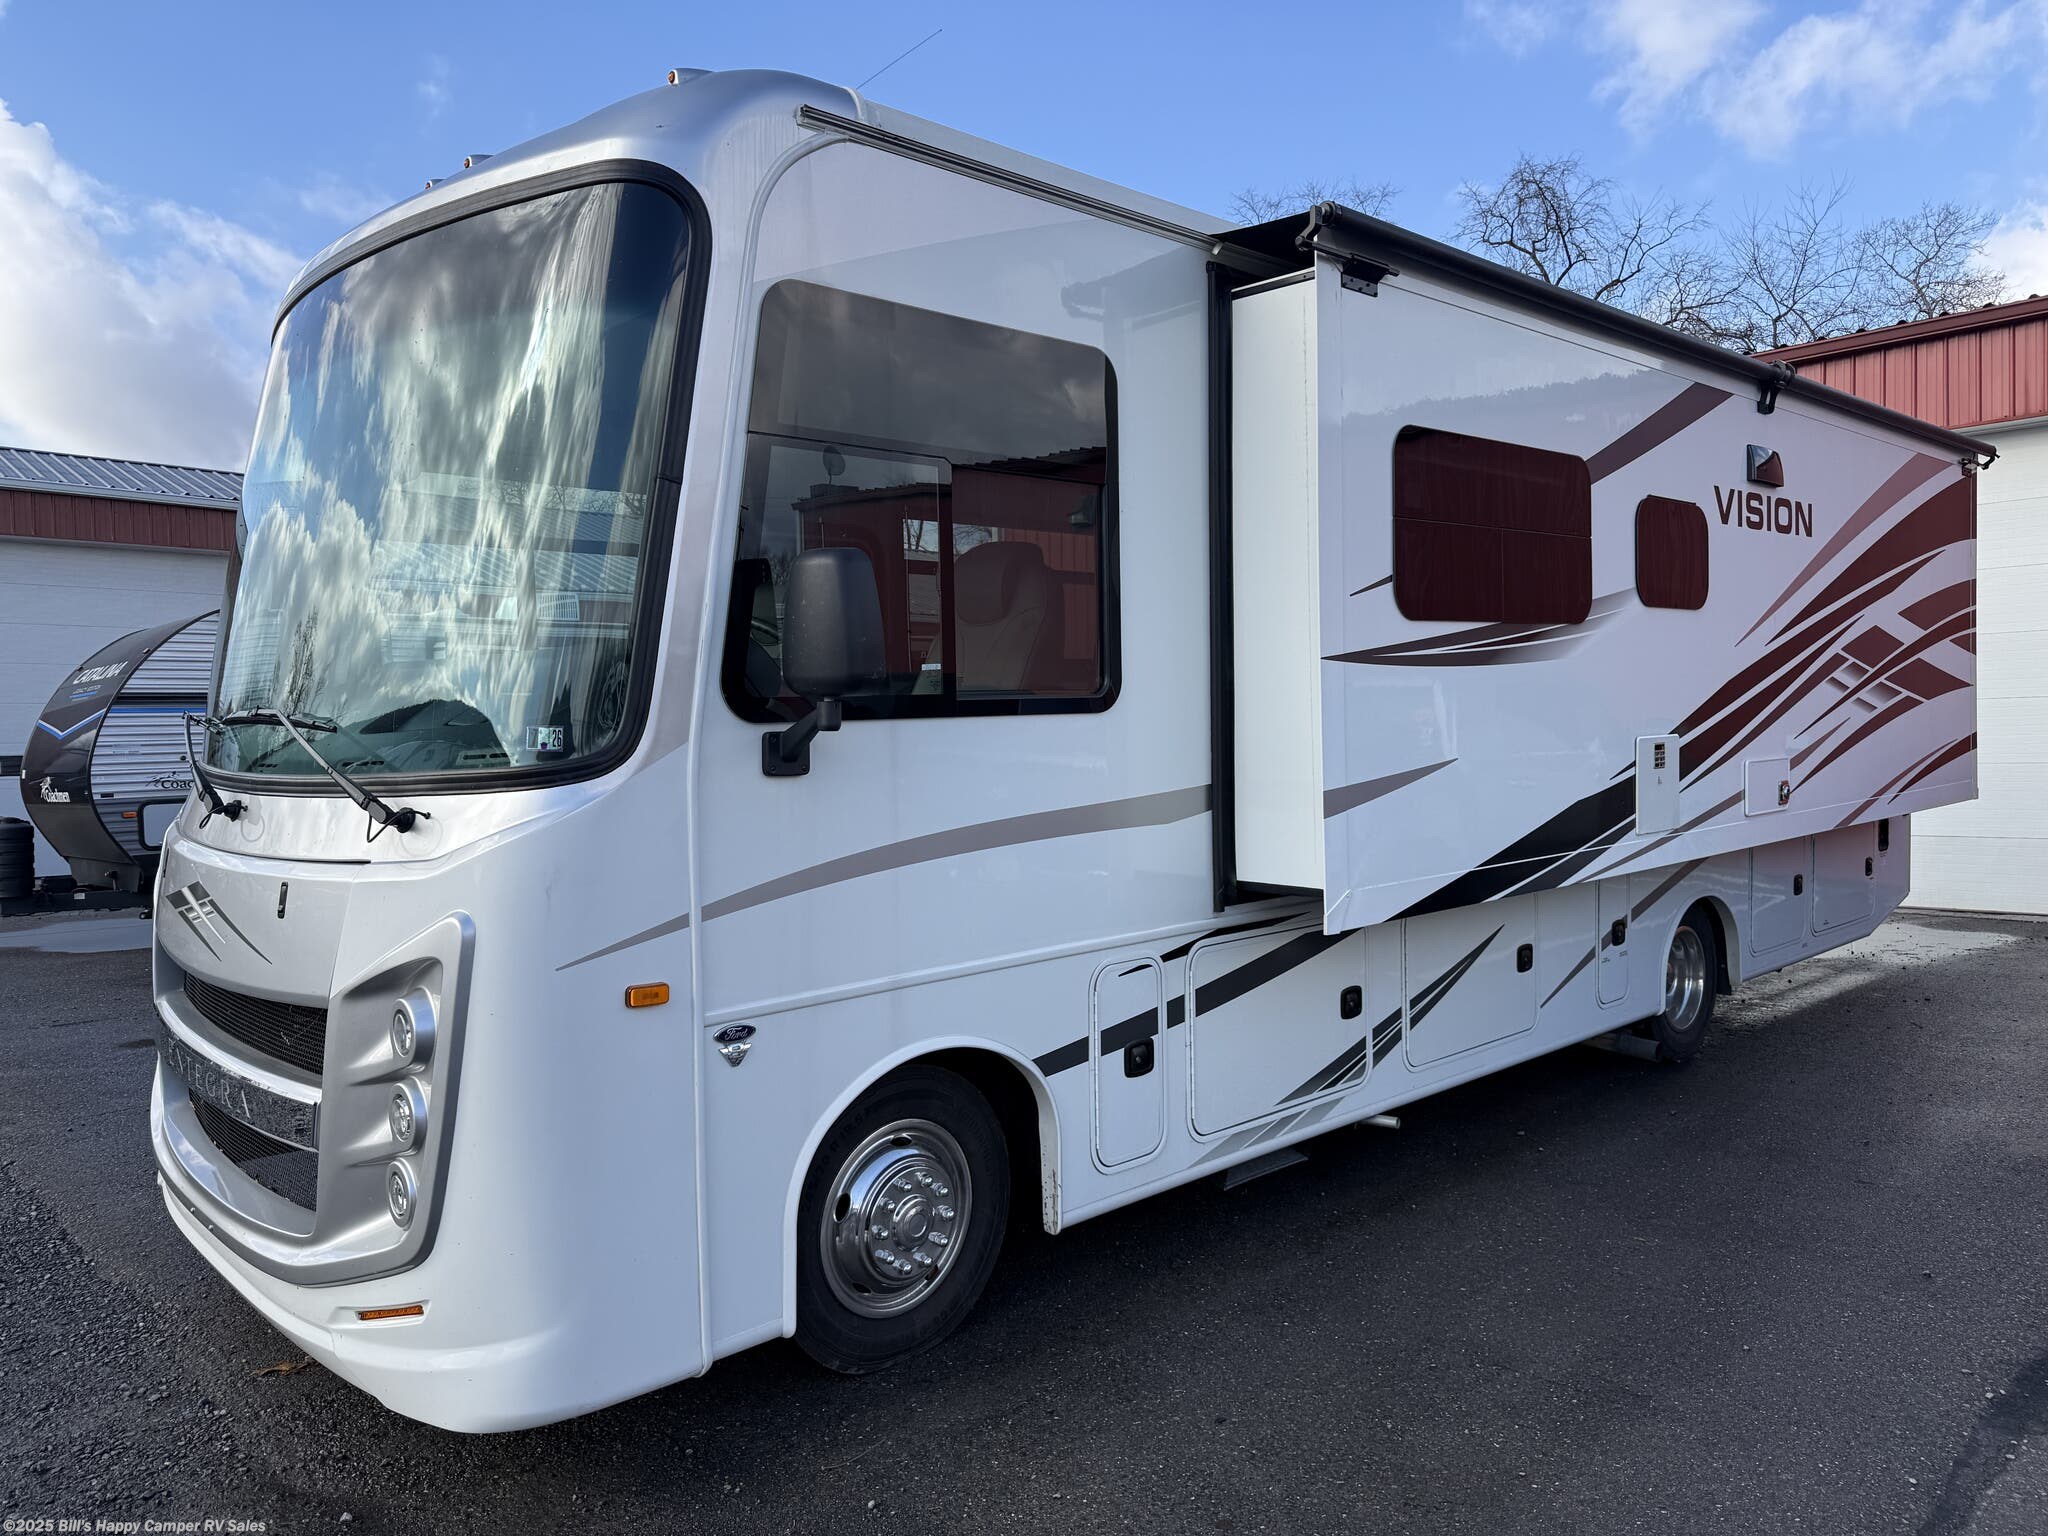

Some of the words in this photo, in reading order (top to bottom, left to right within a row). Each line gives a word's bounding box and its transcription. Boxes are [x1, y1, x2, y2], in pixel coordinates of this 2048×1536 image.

[1714, 485, 1812, 538] VISION
[552, 729, 562, 747] 26
[161, 780, 194, 789] Coac
[725, 1027, 748, 1040] Ford
[167, 1037, 251, 1119] ENTEGRA
